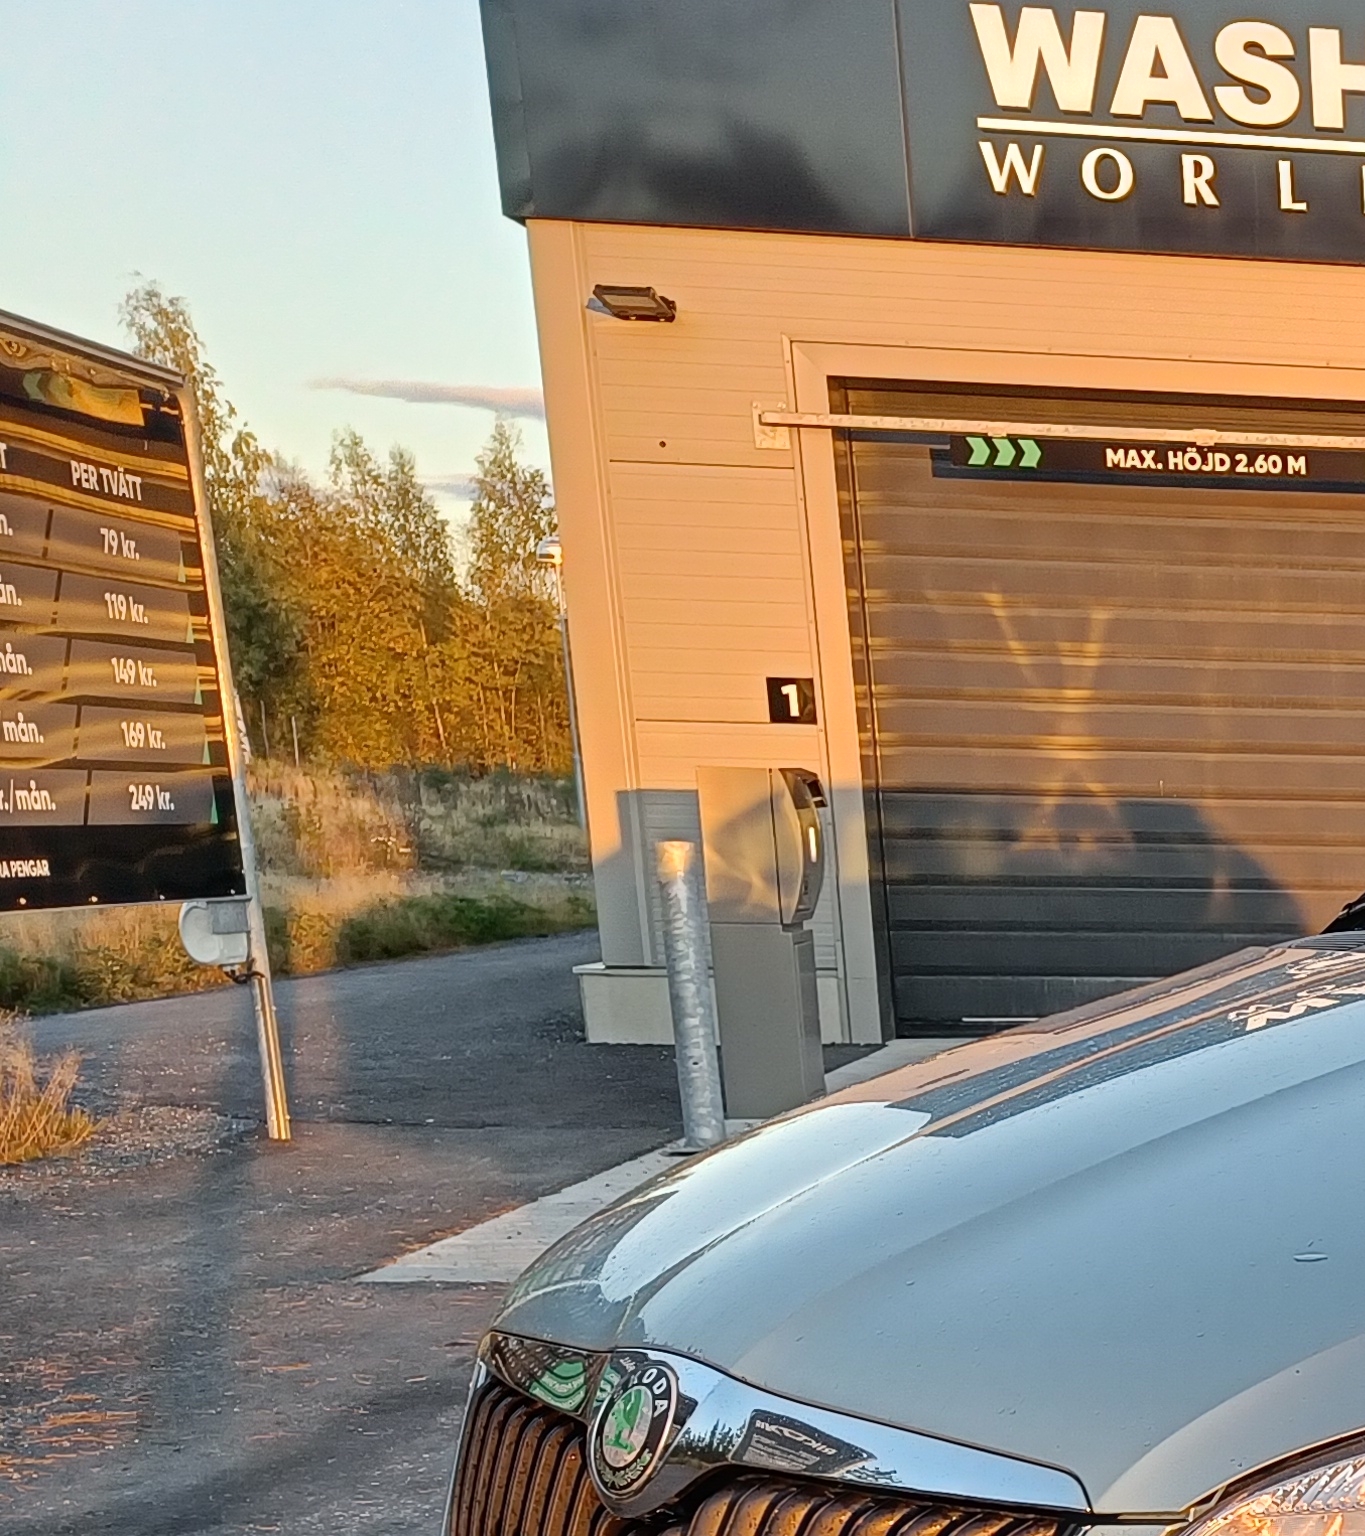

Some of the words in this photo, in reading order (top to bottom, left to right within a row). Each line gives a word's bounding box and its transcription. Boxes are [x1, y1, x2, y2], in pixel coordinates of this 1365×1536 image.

[1105, 448, 1163, 469] MAX.
[1168, 447, 1231, 471] HÖJD
[1235, 453, 1282, 474] 2.60
[1287, 455, 1307, 475] M
[70, 460, 99, 491] PER
[100, 465, 142, 501] TVÄTT
[100, 528, 118, 556] 79
[121, 531, 140, 560] kr.
[104, 592, 127, 620] 119
[129, 596, 148, 624] kr.
[111, 657, 136, 684] 149
[138, 660, 157, 687] kr.
[781, 684, 800, 717] 1
[121, 722, 145, 748] 169
[147, 723, 166, 749] kr.
[129, 785, 154, 810] 249
[156, 785, 175, 811] kr.
[10, 859, 51, 877] PENGAR
